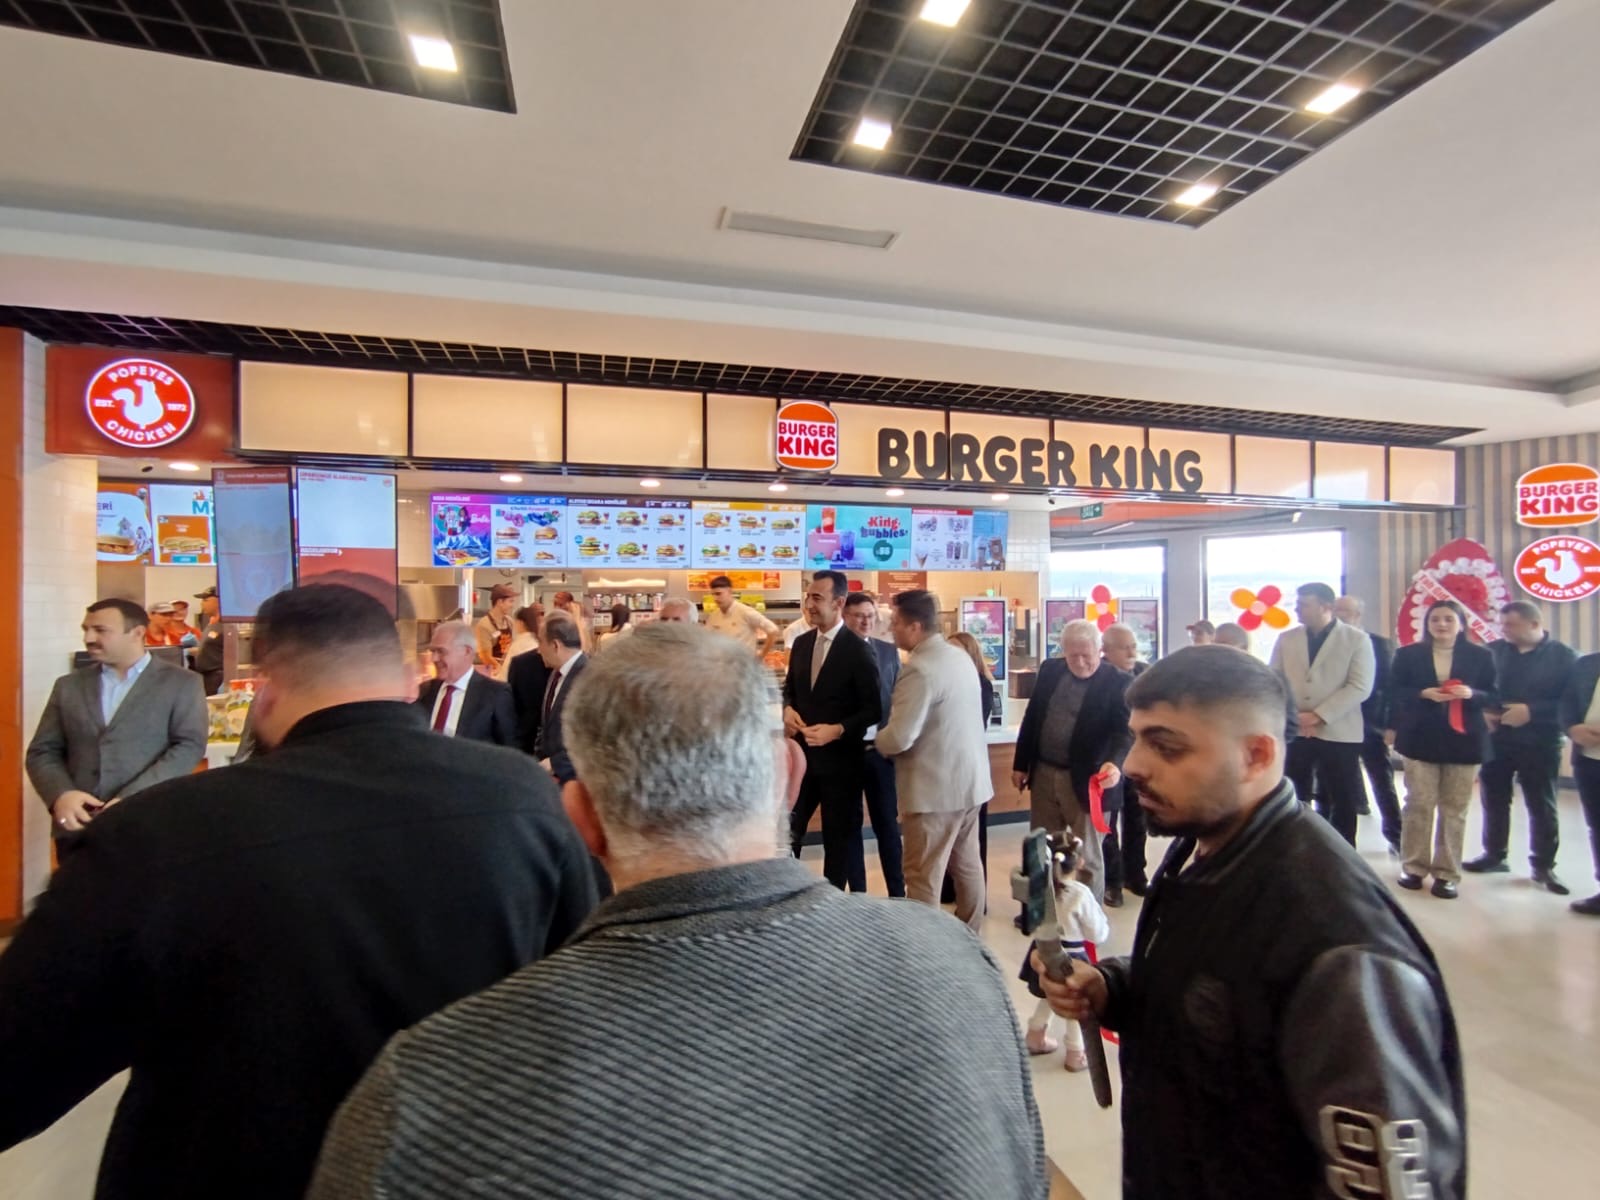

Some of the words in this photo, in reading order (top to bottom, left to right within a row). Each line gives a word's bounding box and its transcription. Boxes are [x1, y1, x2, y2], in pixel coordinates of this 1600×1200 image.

[107, 364, 175, 386] POPEYES
[106, 420, 176, 441] CHICKEN
[778, 421, 836, 438] BURGER
[778, 435, 836, 457] KING
[878, 427, 1077, 486] BURGER
[1089, 443, 1203, 494] KING
[1519, 481, 1598, 499] BURGER
[1520, 494, 1599, 516] KING
[867, 515, 901, 531] King
[1532, 540, 1591, 555] POPEYES
[1530, 581, 1593, 598] CHICKEN
